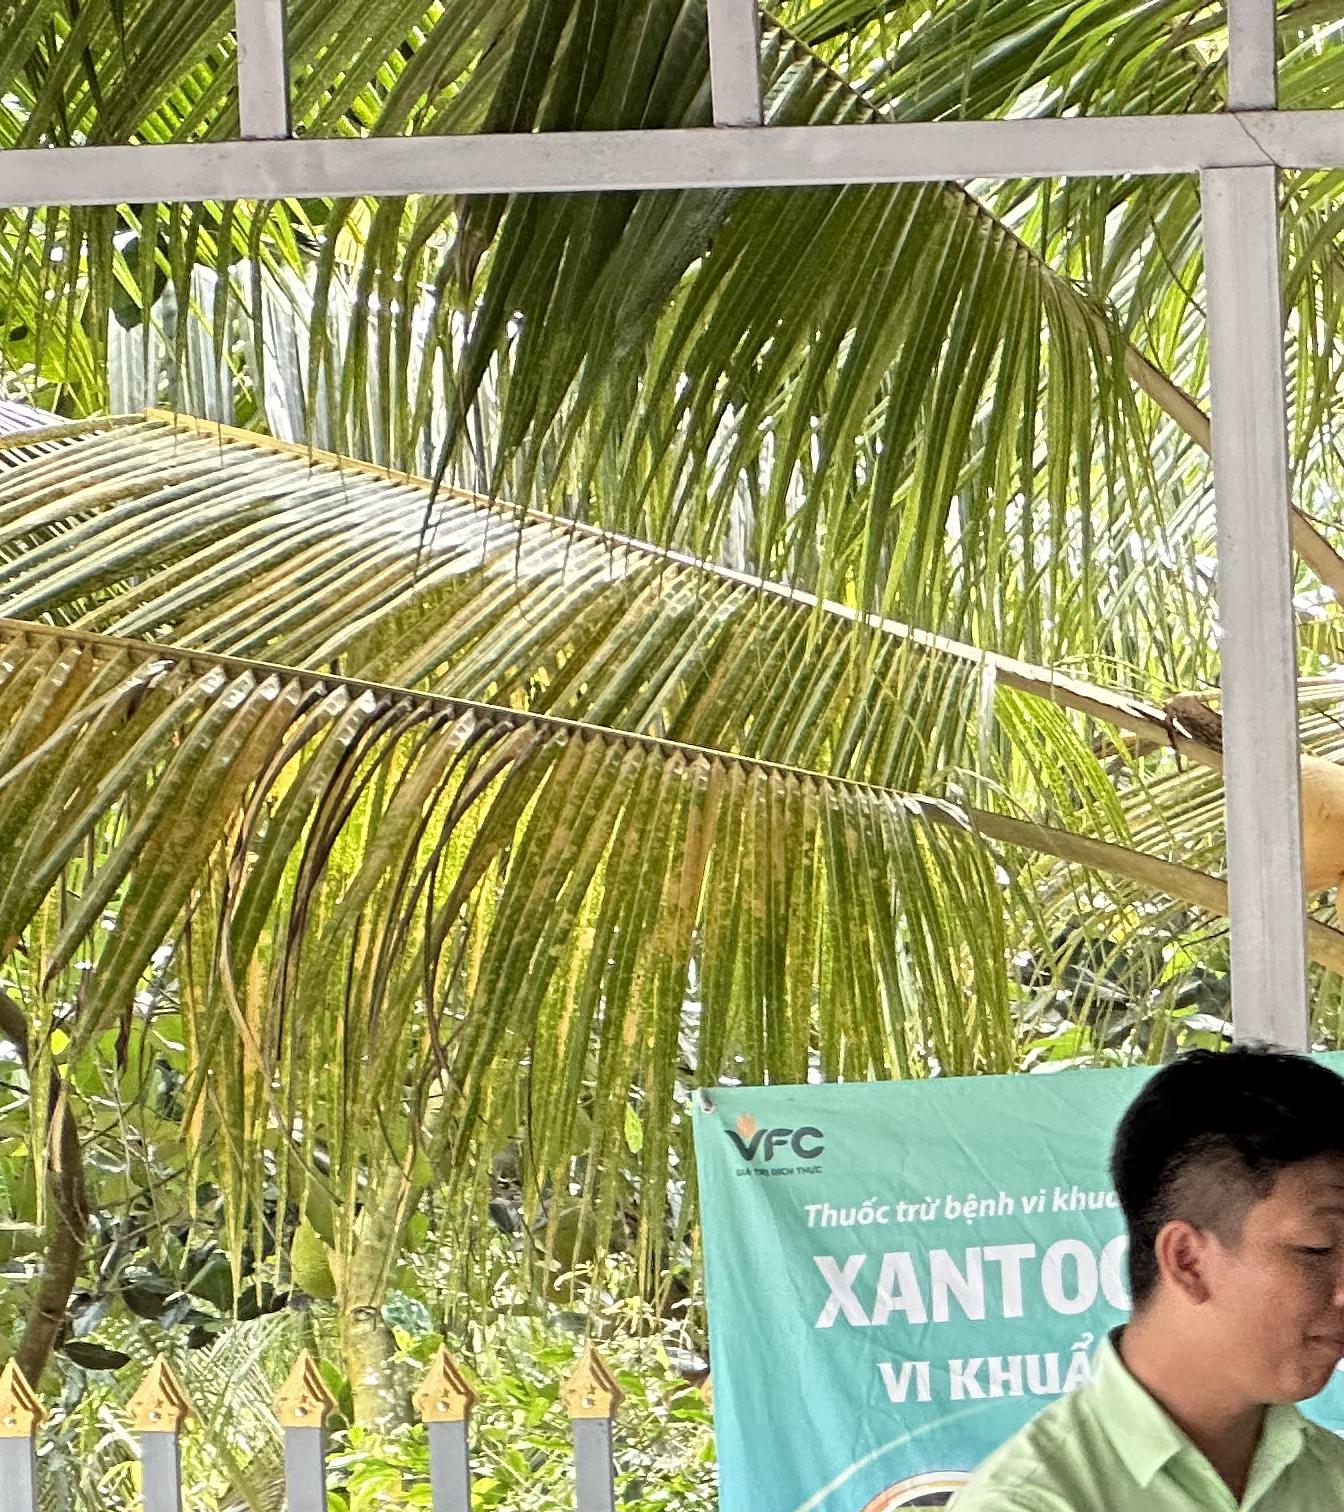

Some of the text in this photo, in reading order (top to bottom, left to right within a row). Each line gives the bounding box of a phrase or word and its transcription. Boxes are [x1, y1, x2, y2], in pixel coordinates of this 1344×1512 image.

[724, 1126, 825, 1162] VFC
[804, 1197, 889, 1229] Thuốc
[896, 1197, 940, 1223] trừ
[945, 1191, 1014, 1226] bệnh
[1020, 1190, 1046, 1214] vi
[813, 1234, 1133, 1329] XANTOC
[876, 1332, 1095, 1404] VI KHUẨ
